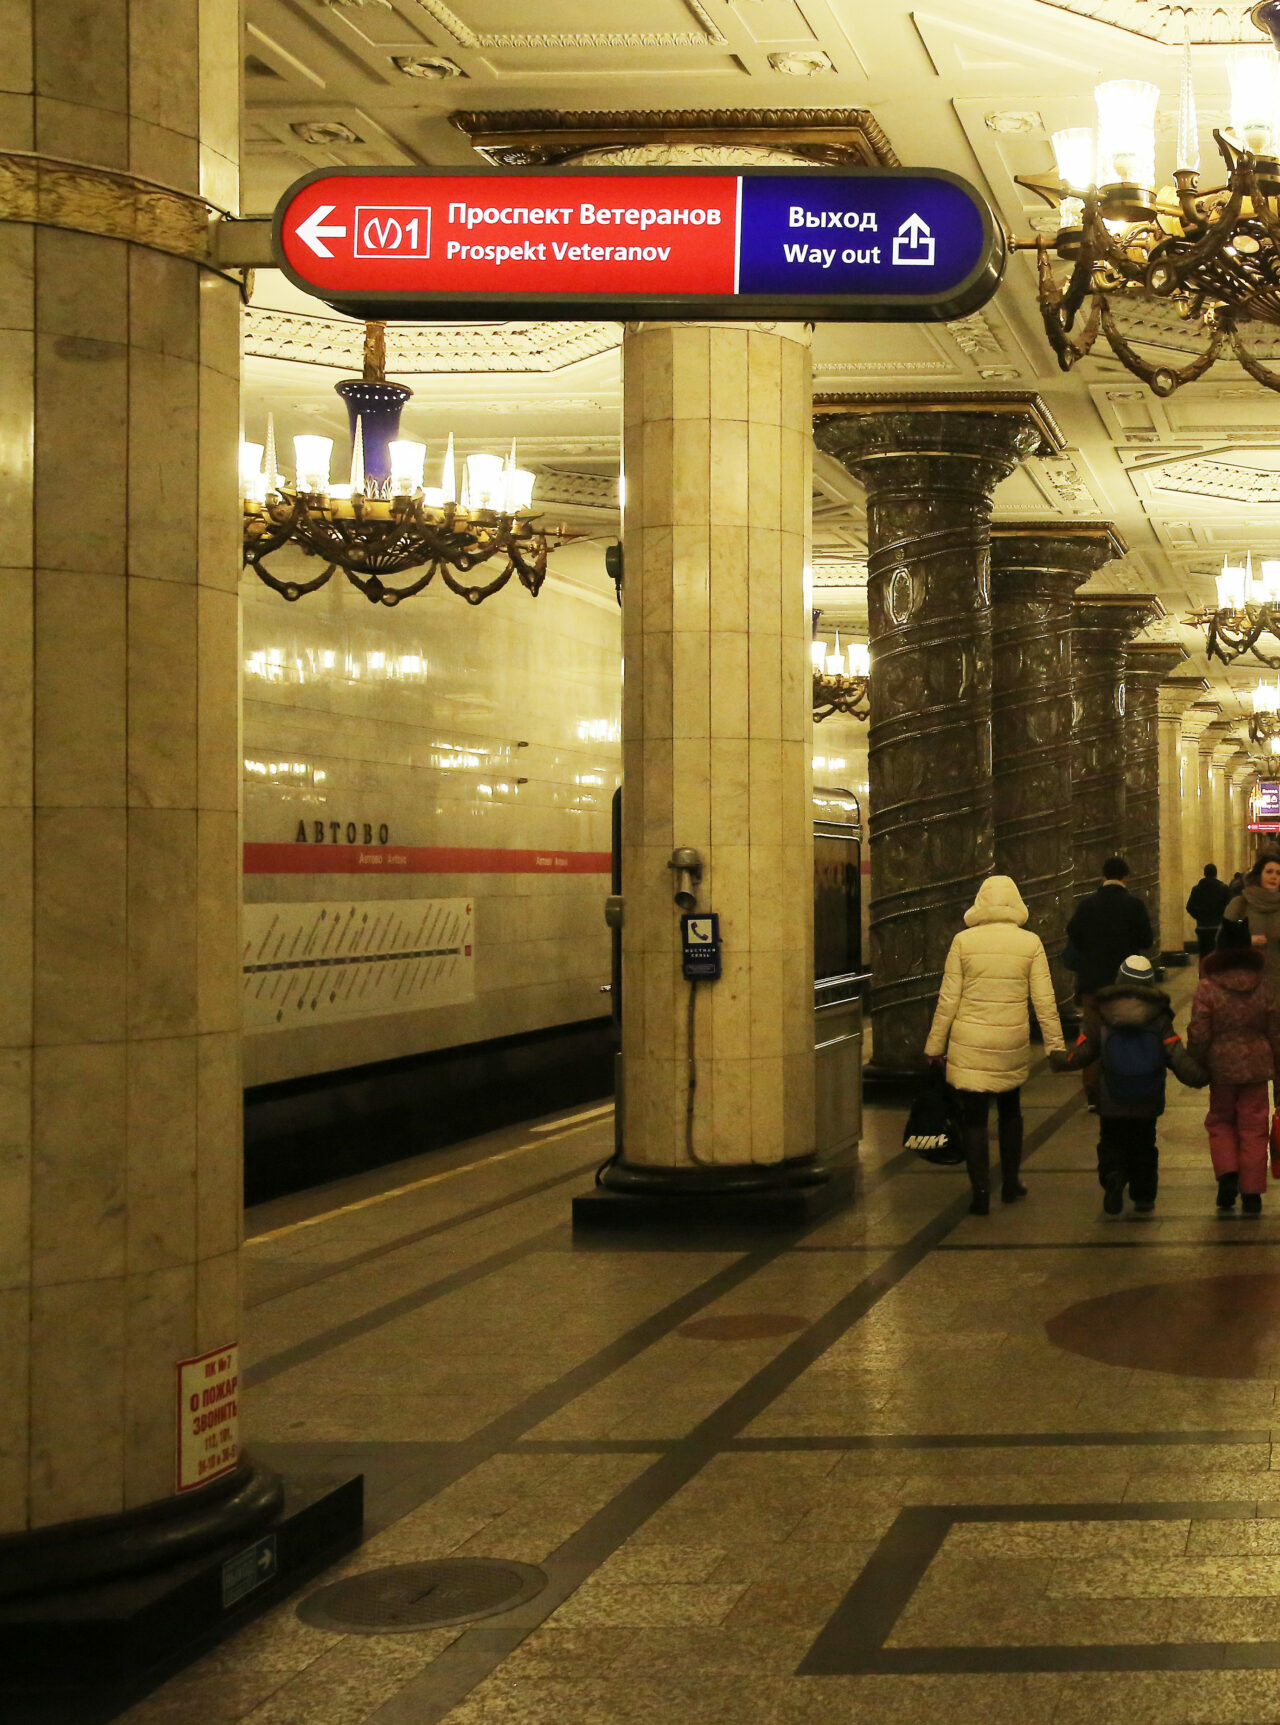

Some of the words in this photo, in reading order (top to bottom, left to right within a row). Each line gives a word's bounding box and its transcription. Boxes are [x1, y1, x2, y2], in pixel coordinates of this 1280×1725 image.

[448, 202, 574, 229] Проспект
[579, 203, 722, 231] Ветеранов
[789, 206, 878, 232] Выход
[447, 241, 546, 265] Prospekt
[552, 241, 671, 261] Veteranov
[783, 244, 837, 269] Way
[841, 246, 881, 264] out
[296, 819, 389, 845] АВТОВО
[190, 1392, 199, 1413] О
[202, 1375, 238, 1408] ПОЖАР
